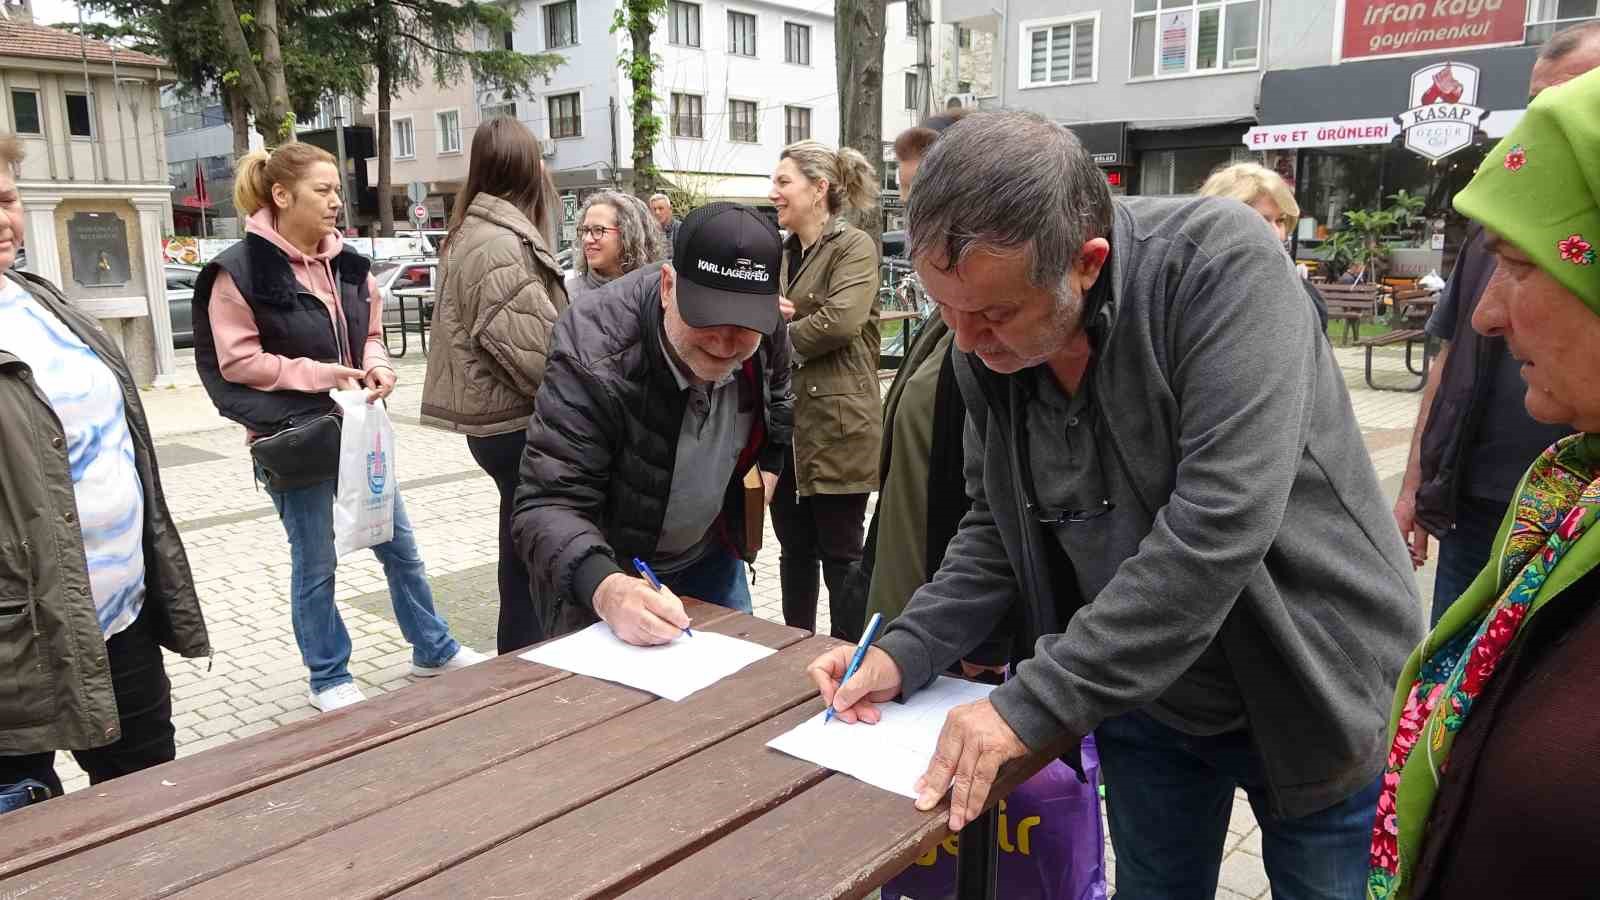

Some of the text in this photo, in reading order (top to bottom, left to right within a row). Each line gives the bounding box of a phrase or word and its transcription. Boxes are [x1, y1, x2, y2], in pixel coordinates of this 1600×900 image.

[1369, 20, 1491, 51] gayrimenkul
[1413, 106, 1471, 123] KASAP
[1253, 123, 1389, 145] ET ve ET ÜRÜNLERİ
[697, 259, 770, 282] KARL LAGERFELD
